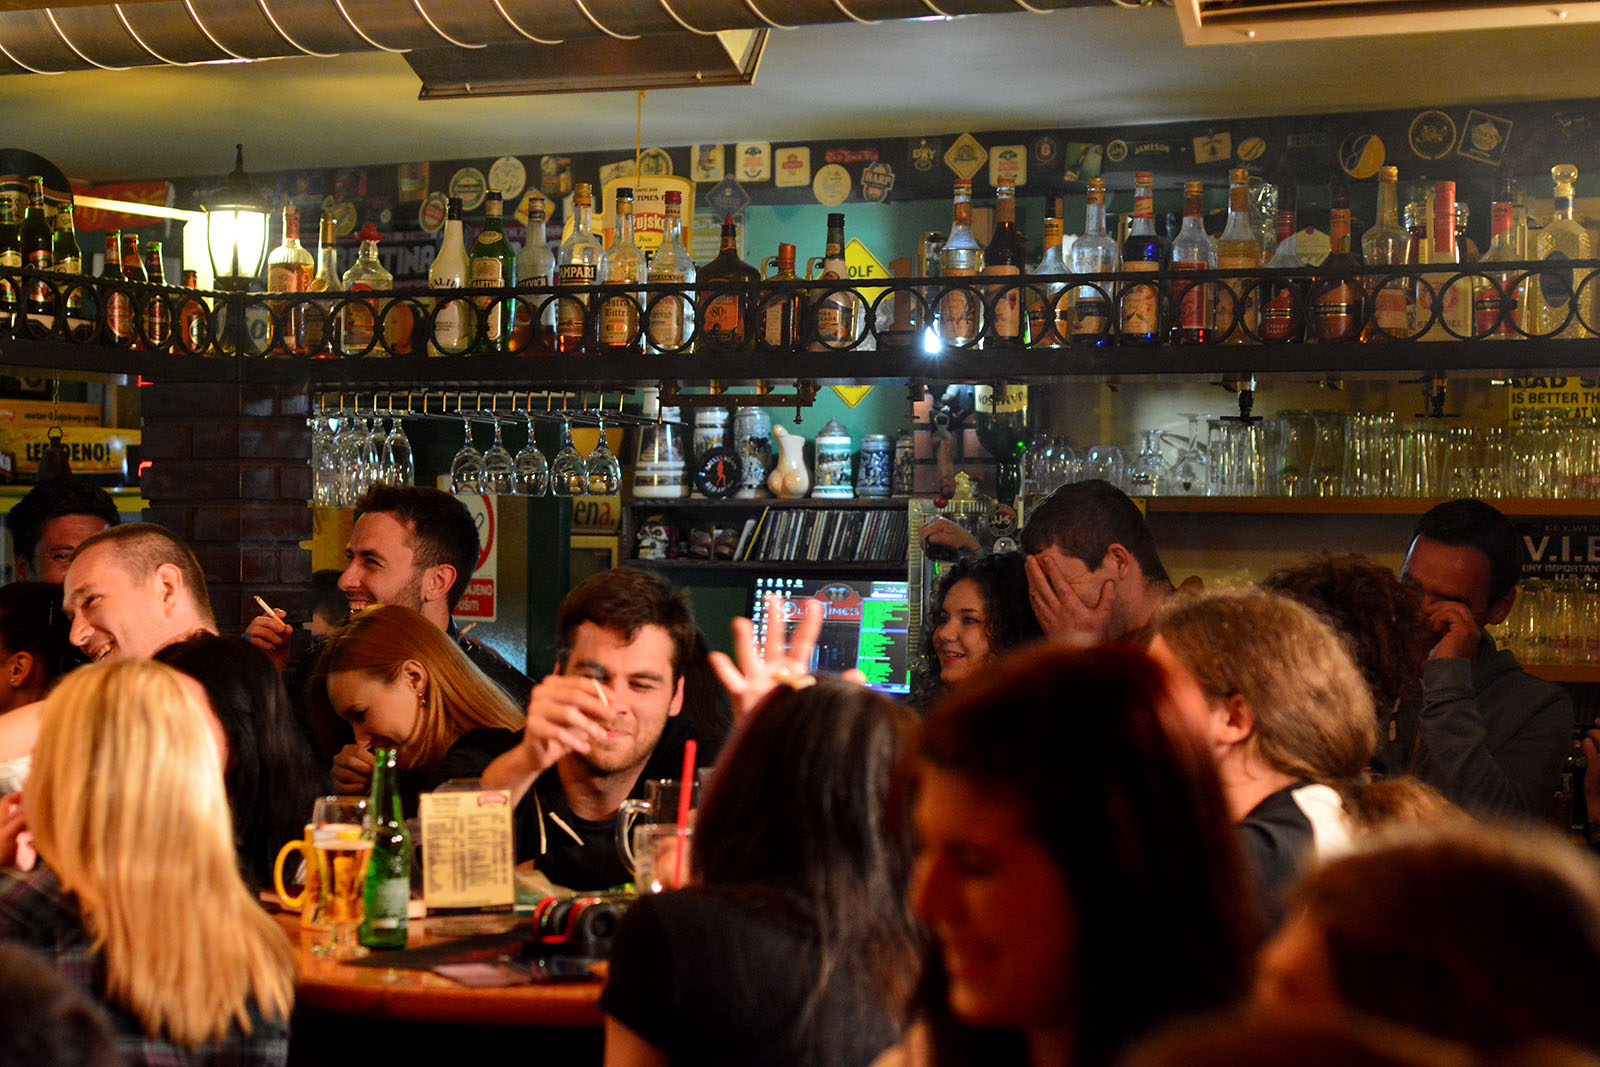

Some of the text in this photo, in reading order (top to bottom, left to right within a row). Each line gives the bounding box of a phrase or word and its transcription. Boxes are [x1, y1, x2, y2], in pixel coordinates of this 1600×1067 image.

[864, 173, 893, 187] HARP
[637, 194, 660, 202] TIMES
[559, 266, 595, 279] AMPARI
[1512, 392, 1524, 404] IS
[1528, 392, 1579, 404] BETTER
